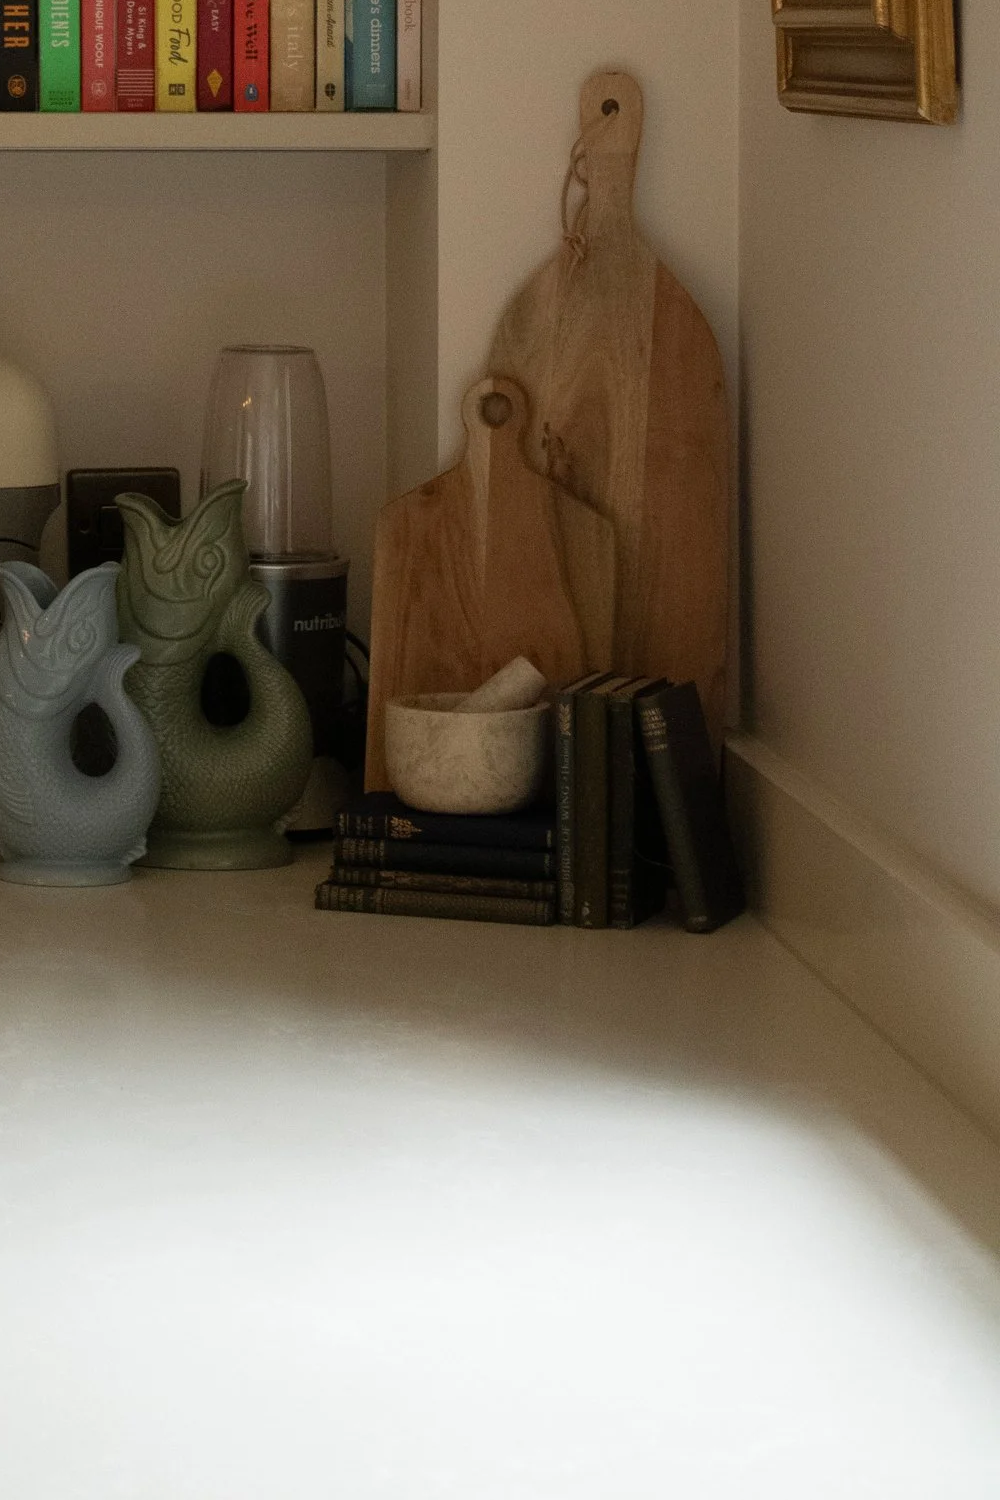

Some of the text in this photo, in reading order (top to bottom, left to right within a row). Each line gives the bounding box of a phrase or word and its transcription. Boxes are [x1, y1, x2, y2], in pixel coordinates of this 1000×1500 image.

[211, 9, 219, 32] EASY
[94, 33, 104, 68] WOOLF
[168, 27, 190, 65] Food
[370, 18, 382, 73] dinners
